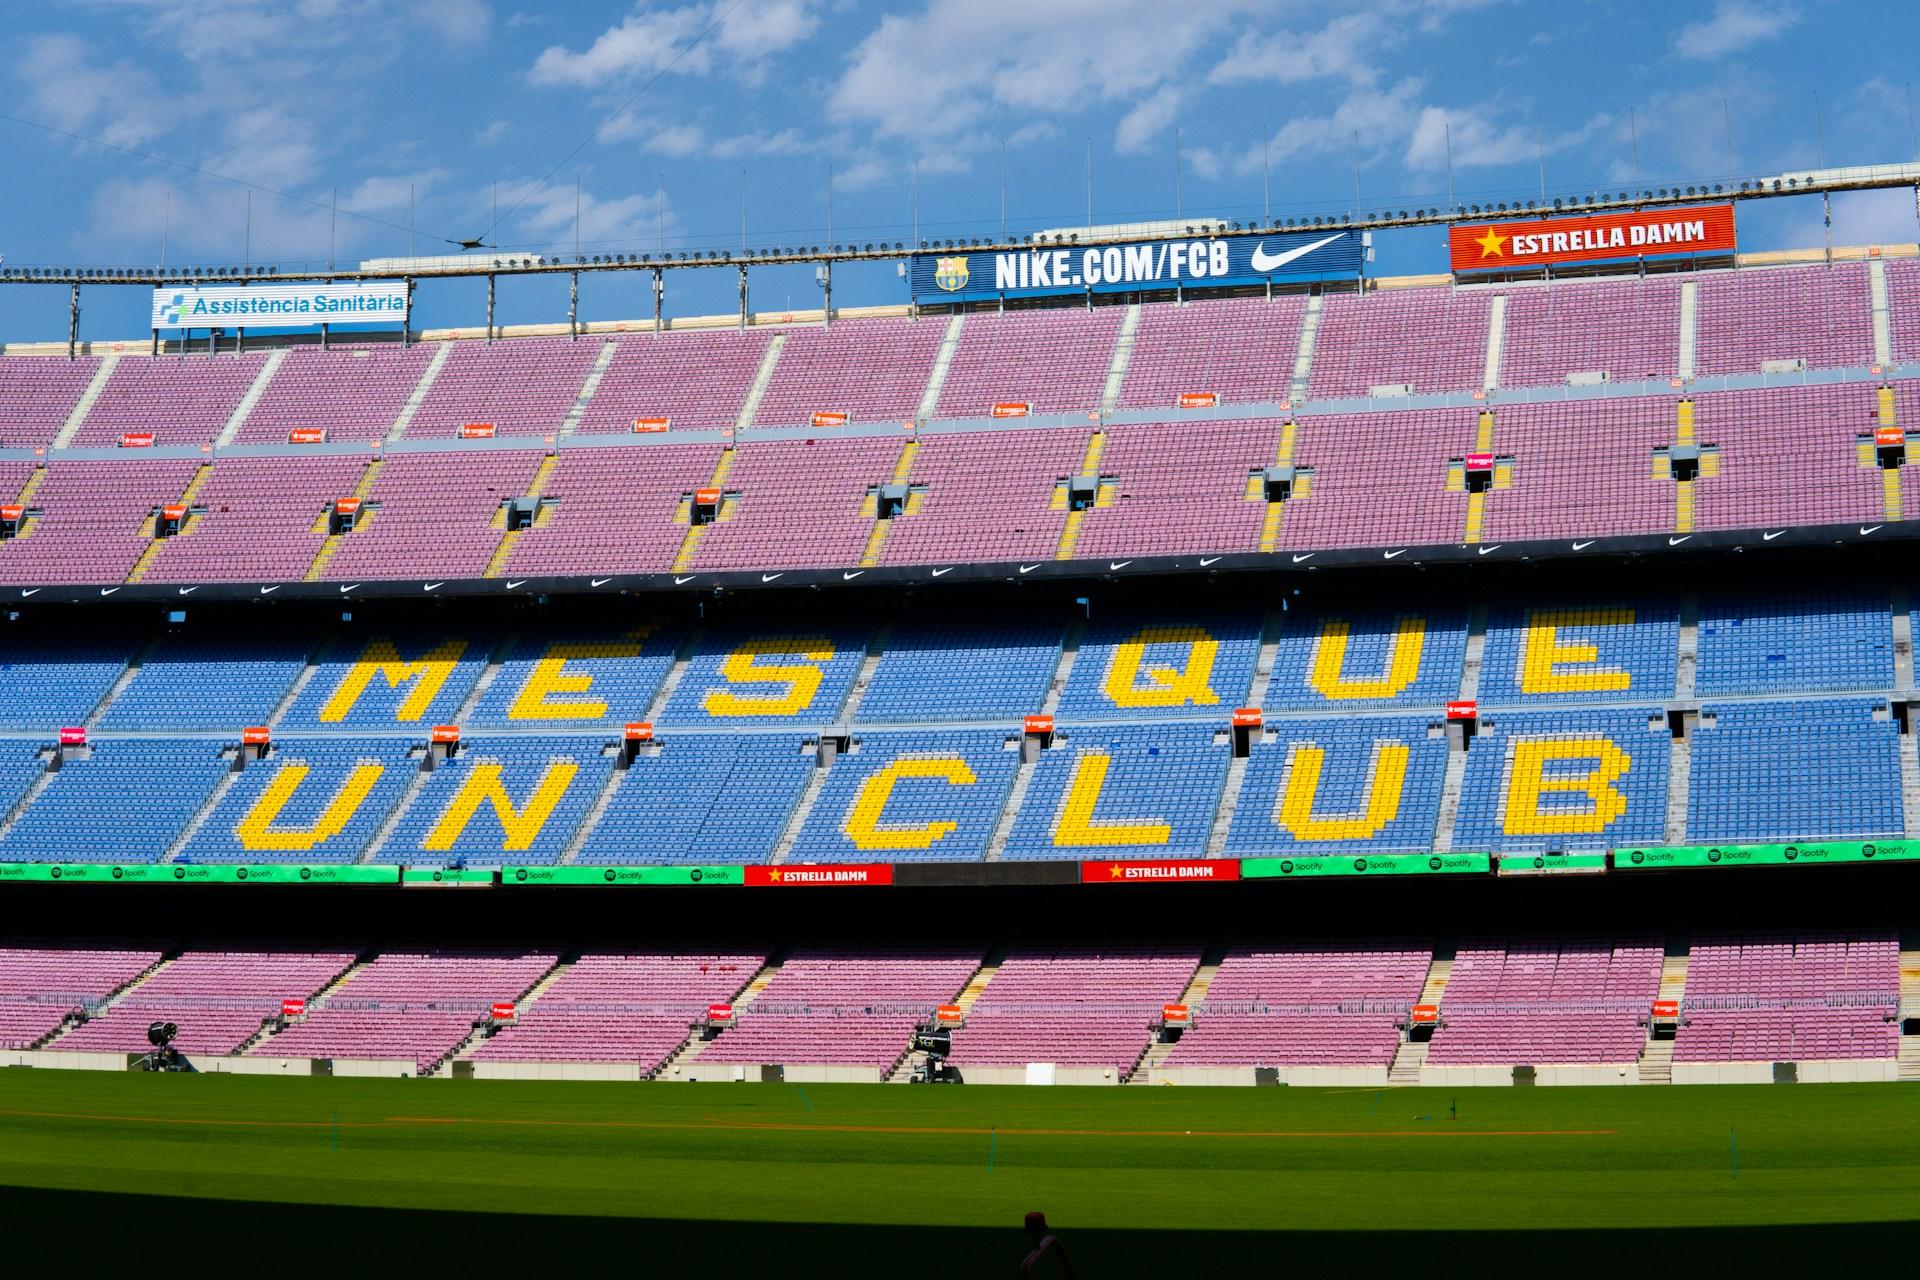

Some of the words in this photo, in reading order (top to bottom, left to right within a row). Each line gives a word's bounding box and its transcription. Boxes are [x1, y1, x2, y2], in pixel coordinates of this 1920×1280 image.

[1512, 227, 1626, 256] ESTRELLA
[1629, 220, 1705, 246] DAMM
[995, 240, 1229, 289] NIKE.COM/FCB
[193, 296, 310, 314] Assistència
[313, 294, 404, 313] Sanitària
[1103, 609, 1636, 708] QUE
[235, 757, 580, 851] UN
[843, 737, 1633, 850] CLUB
[1723, 850, 1752, 860] Spotify
[1799, 849, 1829, 859] Spotify
[1877, 846, 1906, 856] Spotify
[1545, 858, 1569, 867] Spotify
[1646, 853, 1675, 862] Spotify
[1295, 862, 1323, 872] Spotify
[1368, 860, 1397, 870] Spotify
[1443, 859, 1472, 868] Spotify
[2, 868, 26, 876] Spotify
[63, 868, 87, 877] Spotify
[124, 868, 148, 877] Spotify
[186, 869, 210, 878] Spotify
[249, 870, 273, 879] Spotify
[312, 869, 337, 878] Spotify
[443, 870, 463, 880] Spotify
[528, 870, 554, 880] Spotify
[617, 870, 643, 880] Spotify
[703, 870, 730, 880] Spotify
[783, 871, 834, 882] ESTRELLA
[834, 871, 867, 881] DAMM
[1125, 866, 1177, 878] ESTRELLA
[1178, 866, 1213, 877] DAMM
